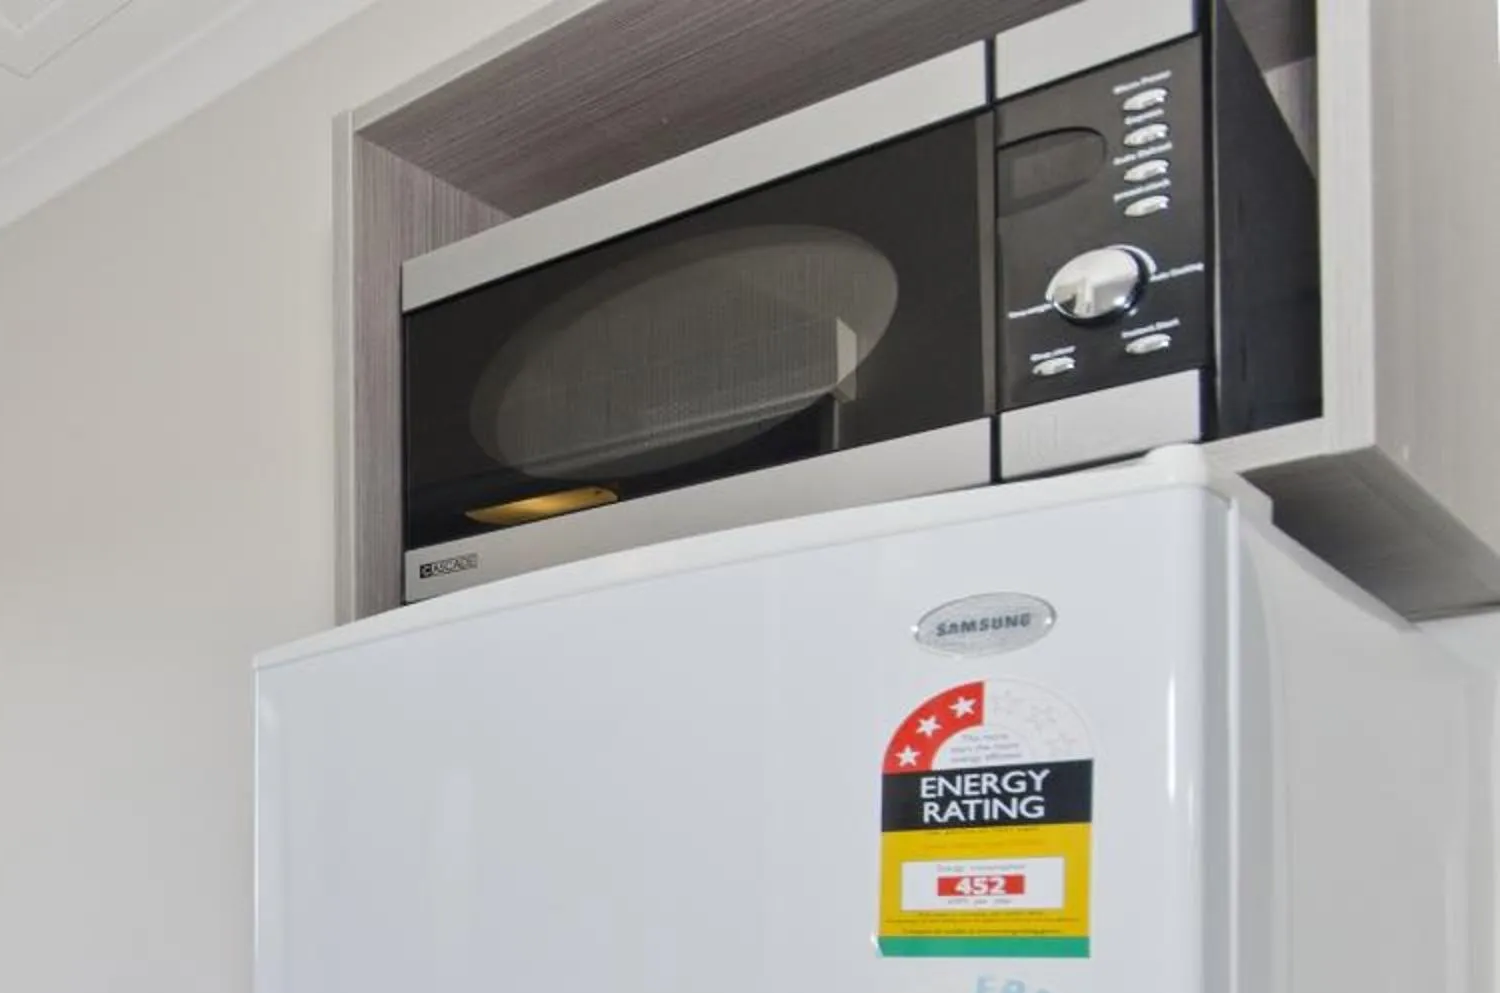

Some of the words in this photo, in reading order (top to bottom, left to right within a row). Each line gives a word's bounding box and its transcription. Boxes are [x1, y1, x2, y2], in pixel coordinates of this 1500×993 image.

[936, 612, 1032, 637] SAMSUNG
[920, 768, 1051, 800] ENERGY
[923, 795, 1045, 825] RATING
[954, 875, 1007, 896] 452
